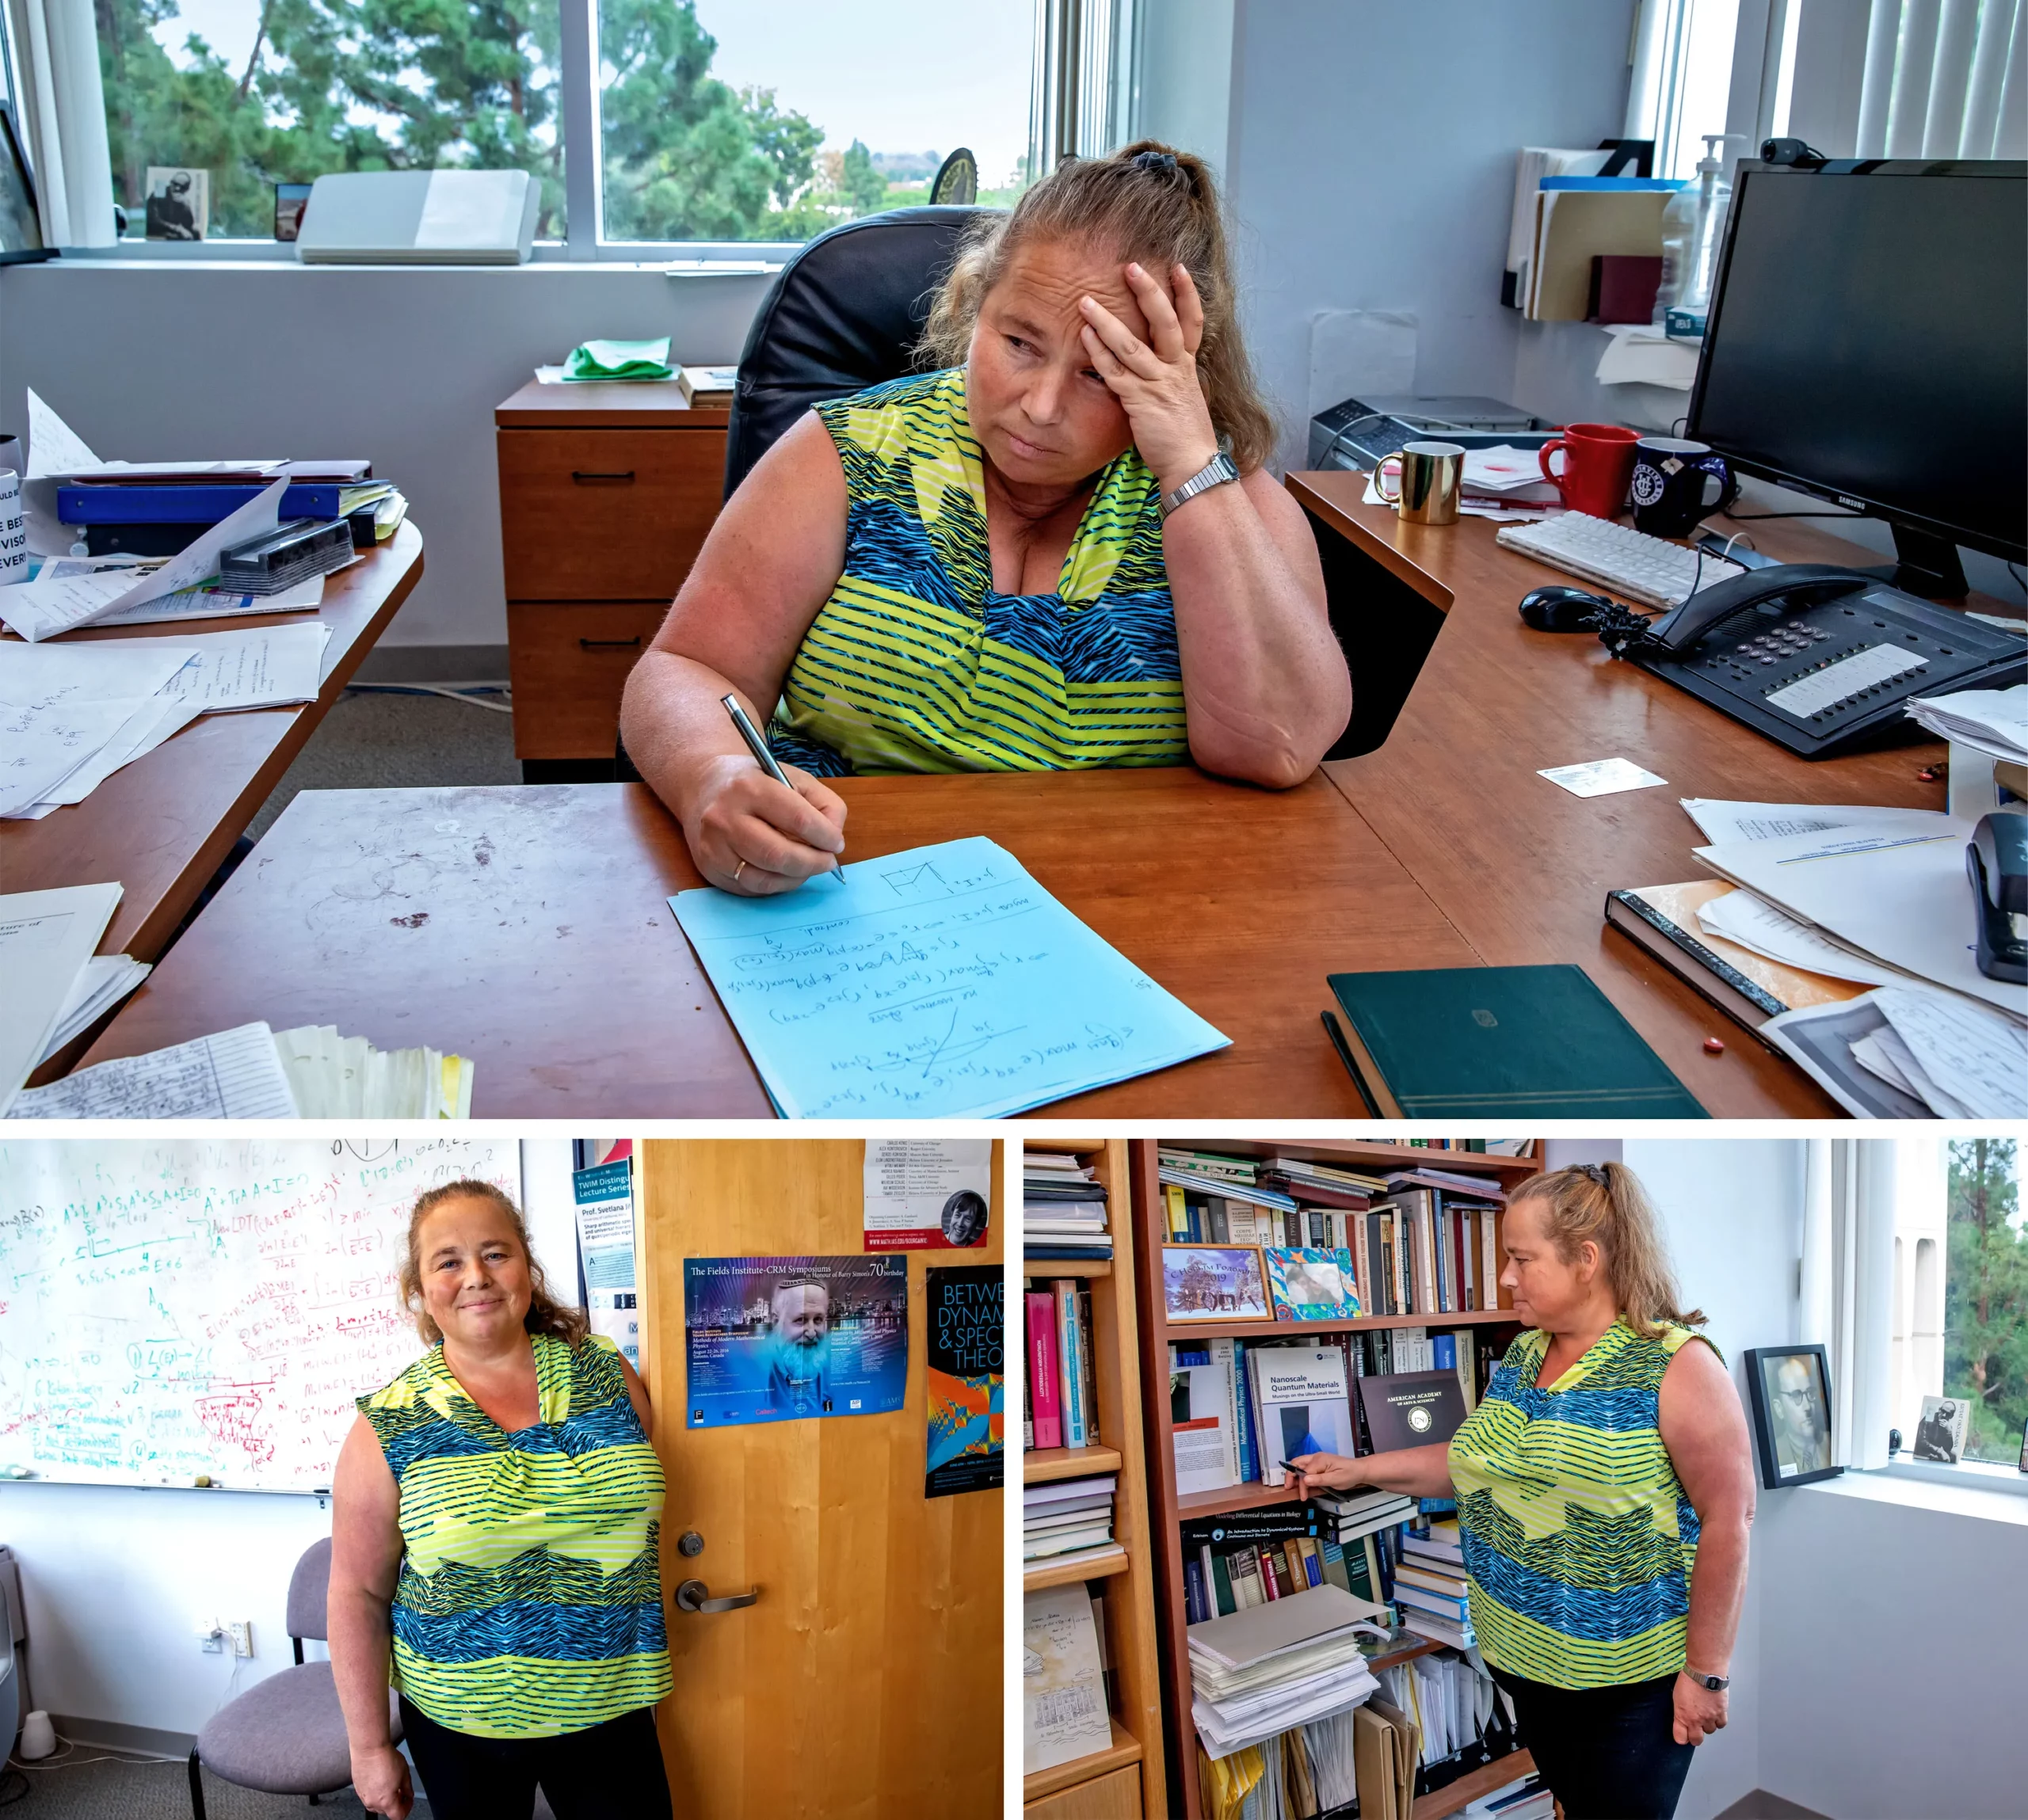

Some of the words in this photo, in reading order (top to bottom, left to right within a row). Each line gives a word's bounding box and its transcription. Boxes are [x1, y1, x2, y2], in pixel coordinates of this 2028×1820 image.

[1839, 496, 1865, 510] SAMSUNG
[1675, 928, 1687, 939] OF
[578, 1180, 597, 1190] TWIM
[580, 1188, 607, 1197] Lecture
[608, 1184, 631, 1194] Series
[582, 1208, 597, 1217] Prof.
[597, 1205, 624, 1214] Svetlana
[707, 1266, 730, 1275] Fields
[732, 1266, 786, 1275] Institute-CRM
[788, 1265, 832, 1275] Symposiums
[939, 1330, 952, 1350] &
[1237, 1386, 1245, 1407] Physics
[1237, 1407, 1247, 1445] Mathematical
